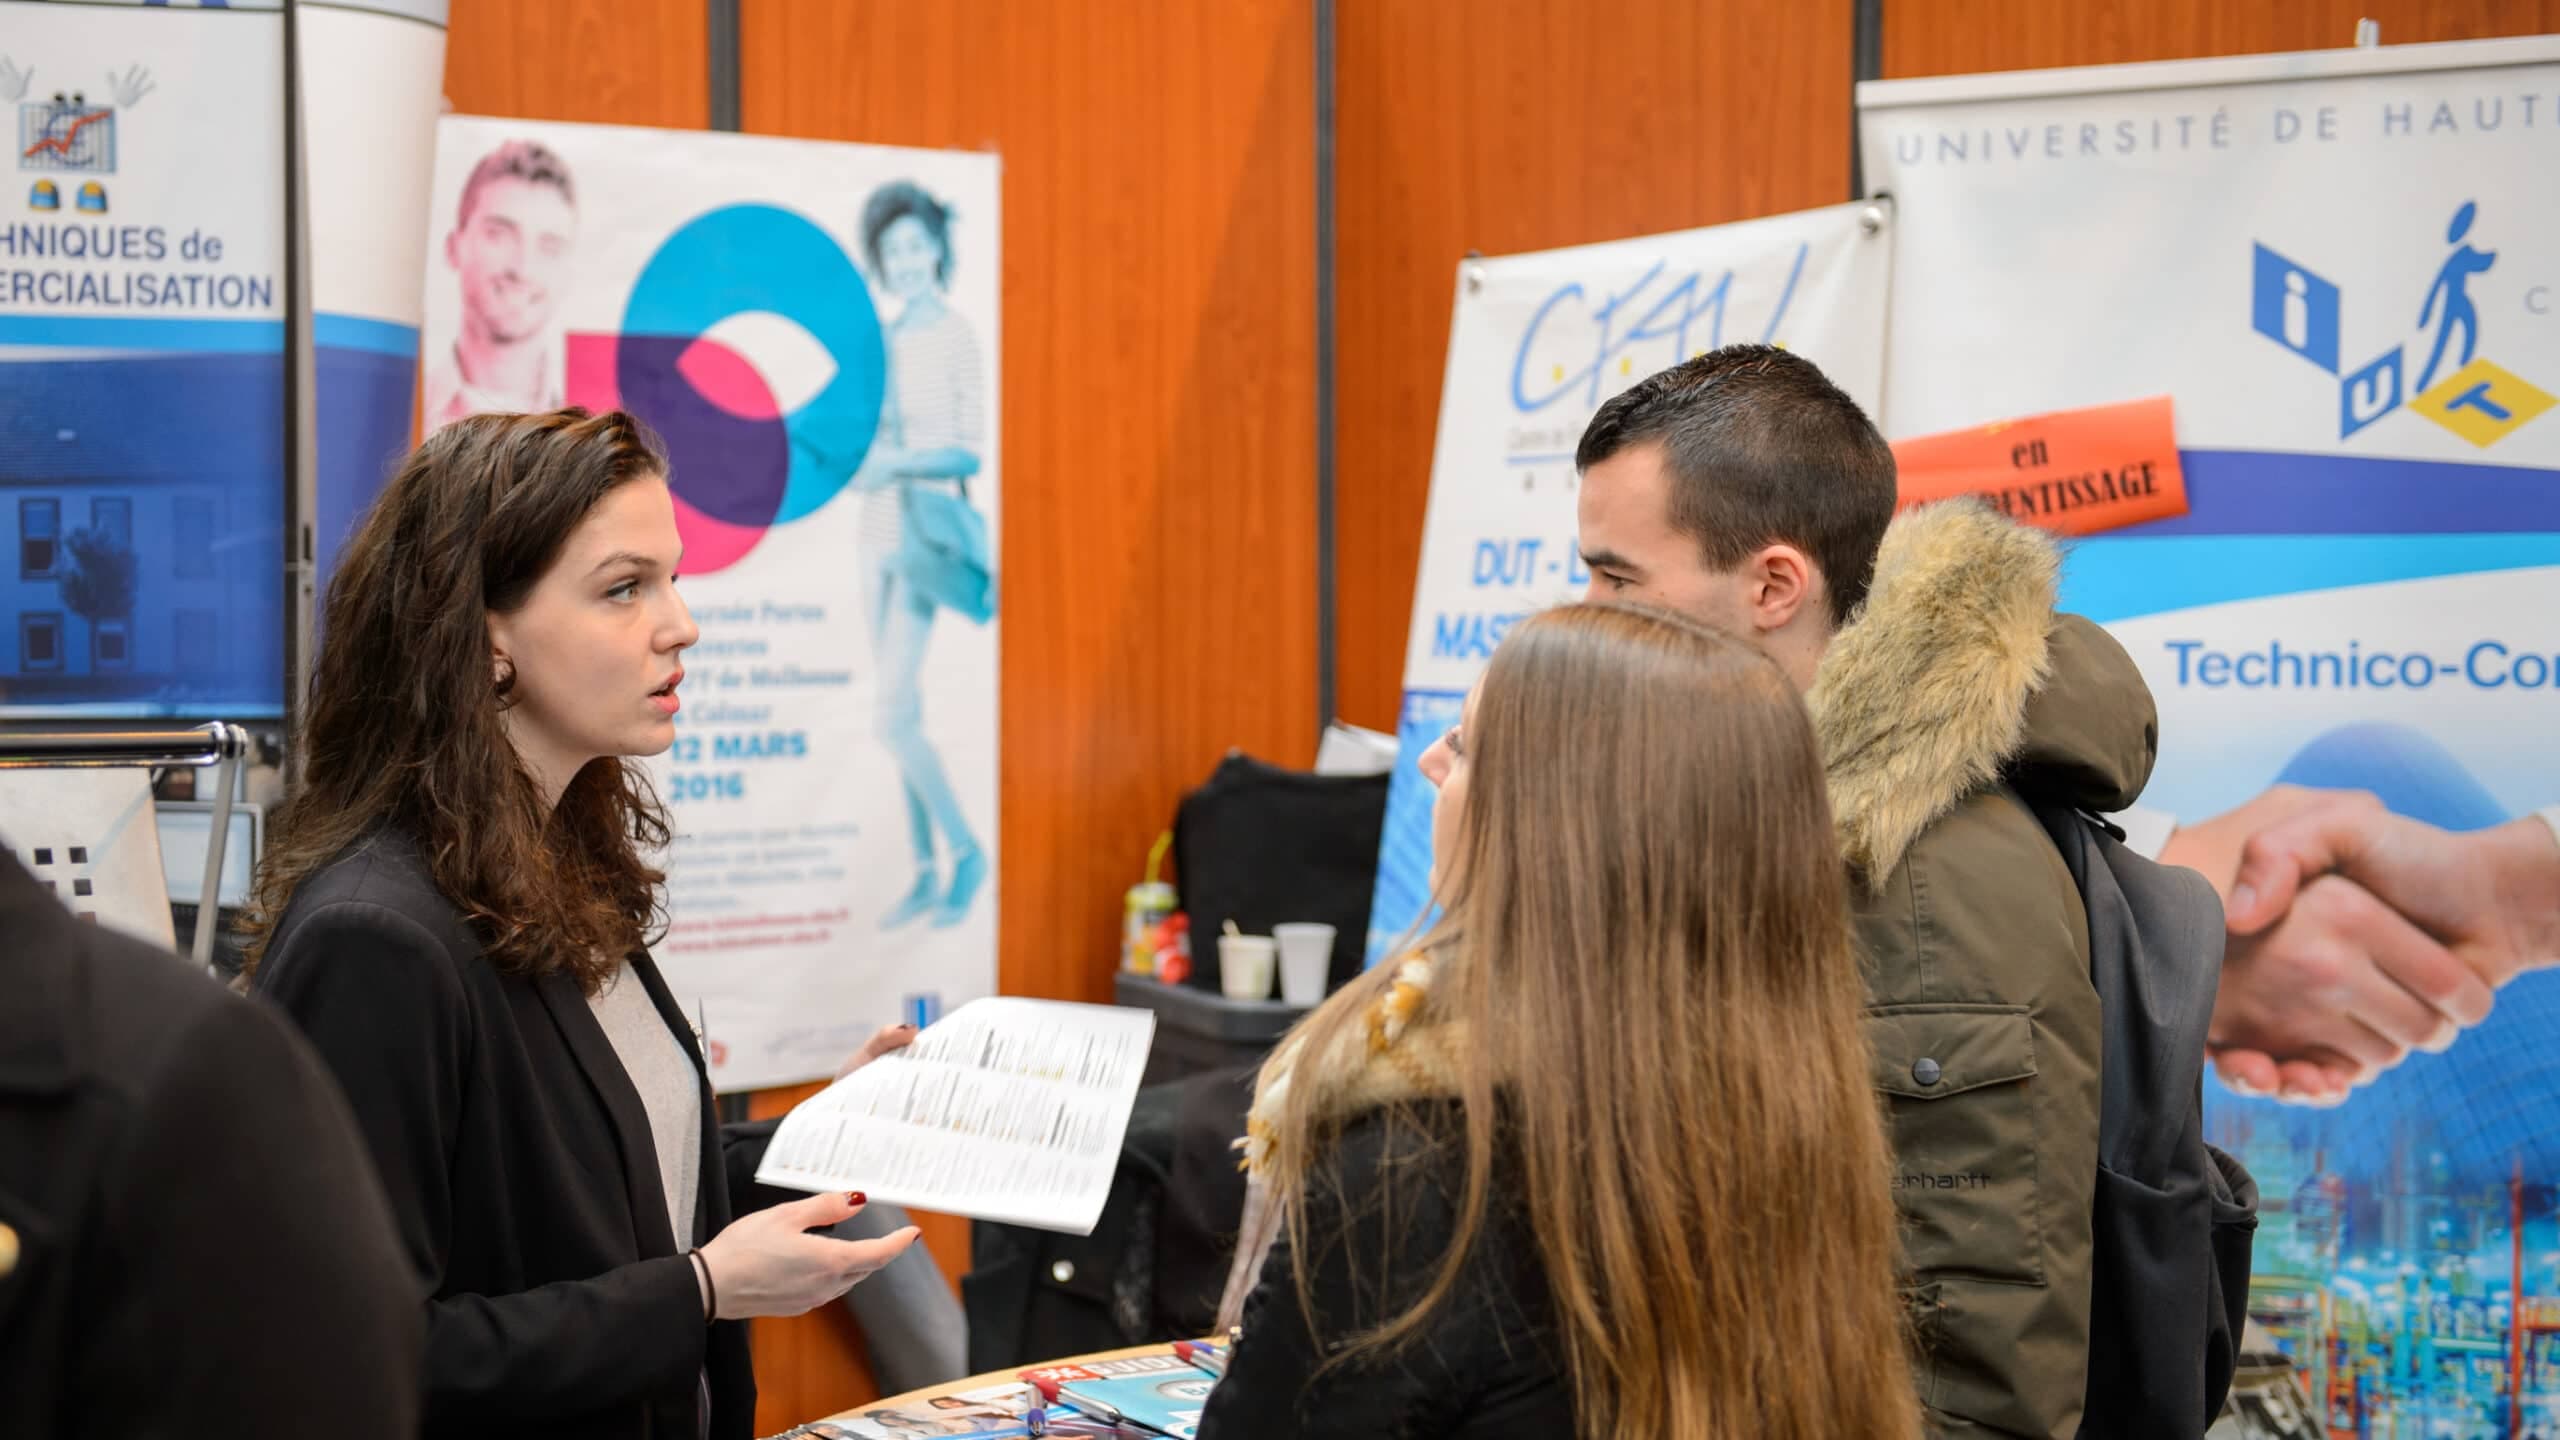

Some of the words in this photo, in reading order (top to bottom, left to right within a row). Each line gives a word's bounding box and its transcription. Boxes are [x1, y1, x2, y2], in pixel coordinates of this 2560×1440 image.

[1897, 107, 2231, 165] UNIVERSITÉ
[2273, 107, 2338, 143] DE
[2383, 95, 2560, 136] HAUT
[180, 229, 223, 261] de
[2011, 438, 2048, 468] en
[1472, 538, 1543, 587] DUT
[1432, 612, 1534, 659] MAS
[2164, 641, 2560, 689] Technico-Co
[672, 735, 702, 762] 12
[713, 729, 807, 760] MARS
[669, 771, 744, 801] 2016
[1890, 1172, 1991, 1190] arhartt
